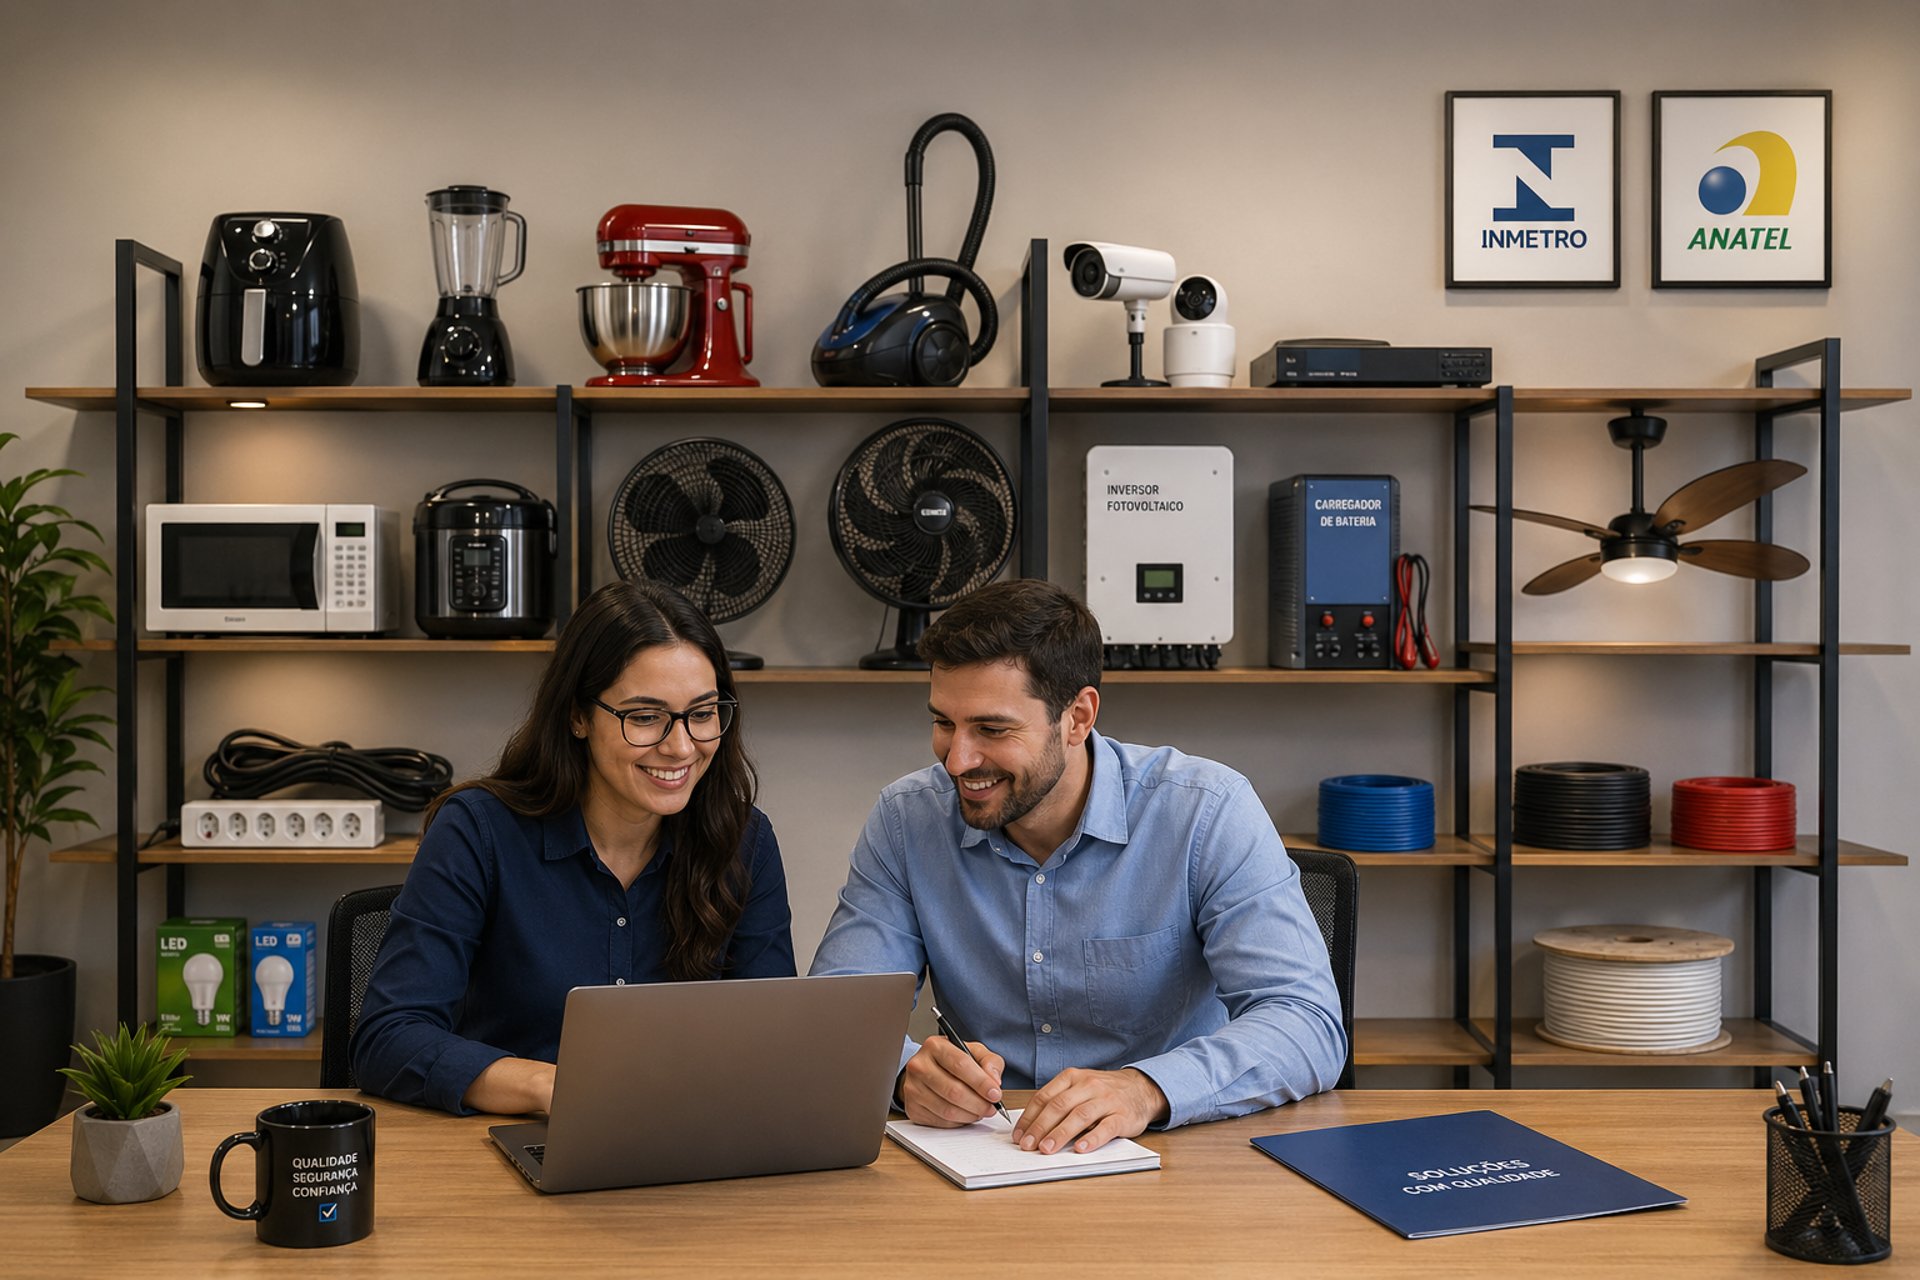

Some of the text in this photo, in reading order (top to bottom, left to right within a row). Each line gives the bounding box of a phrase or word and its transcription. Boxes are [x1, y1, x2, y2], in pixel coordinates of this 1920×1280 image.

[1481, 229, 1588, 249] INMETRO
[1687, 227, 1792, 250] ANATEL
[1106, 484, 1160, 496] INVERSOR
[1106, 500, 1184, 512] FOTOVOLTAICO
[1314, 499, 1382, 511] CARREGADOR
[1320, 516, 1377, 527] DE BATERIA
[160, 937, 188, 951] LED
[255, 935, 278, 947] LED
[292, 1152, 359, 1170] QUALIDADE
[292, 1167, 359, 1184] SEGURANÇA
[1407, 1159, 1531, 1181] SOLUÇÕES
[292, 1181, 359, 1198] CONFIANÇA
[1402, 1168, 1561, 1195] COM QUALIDADE
